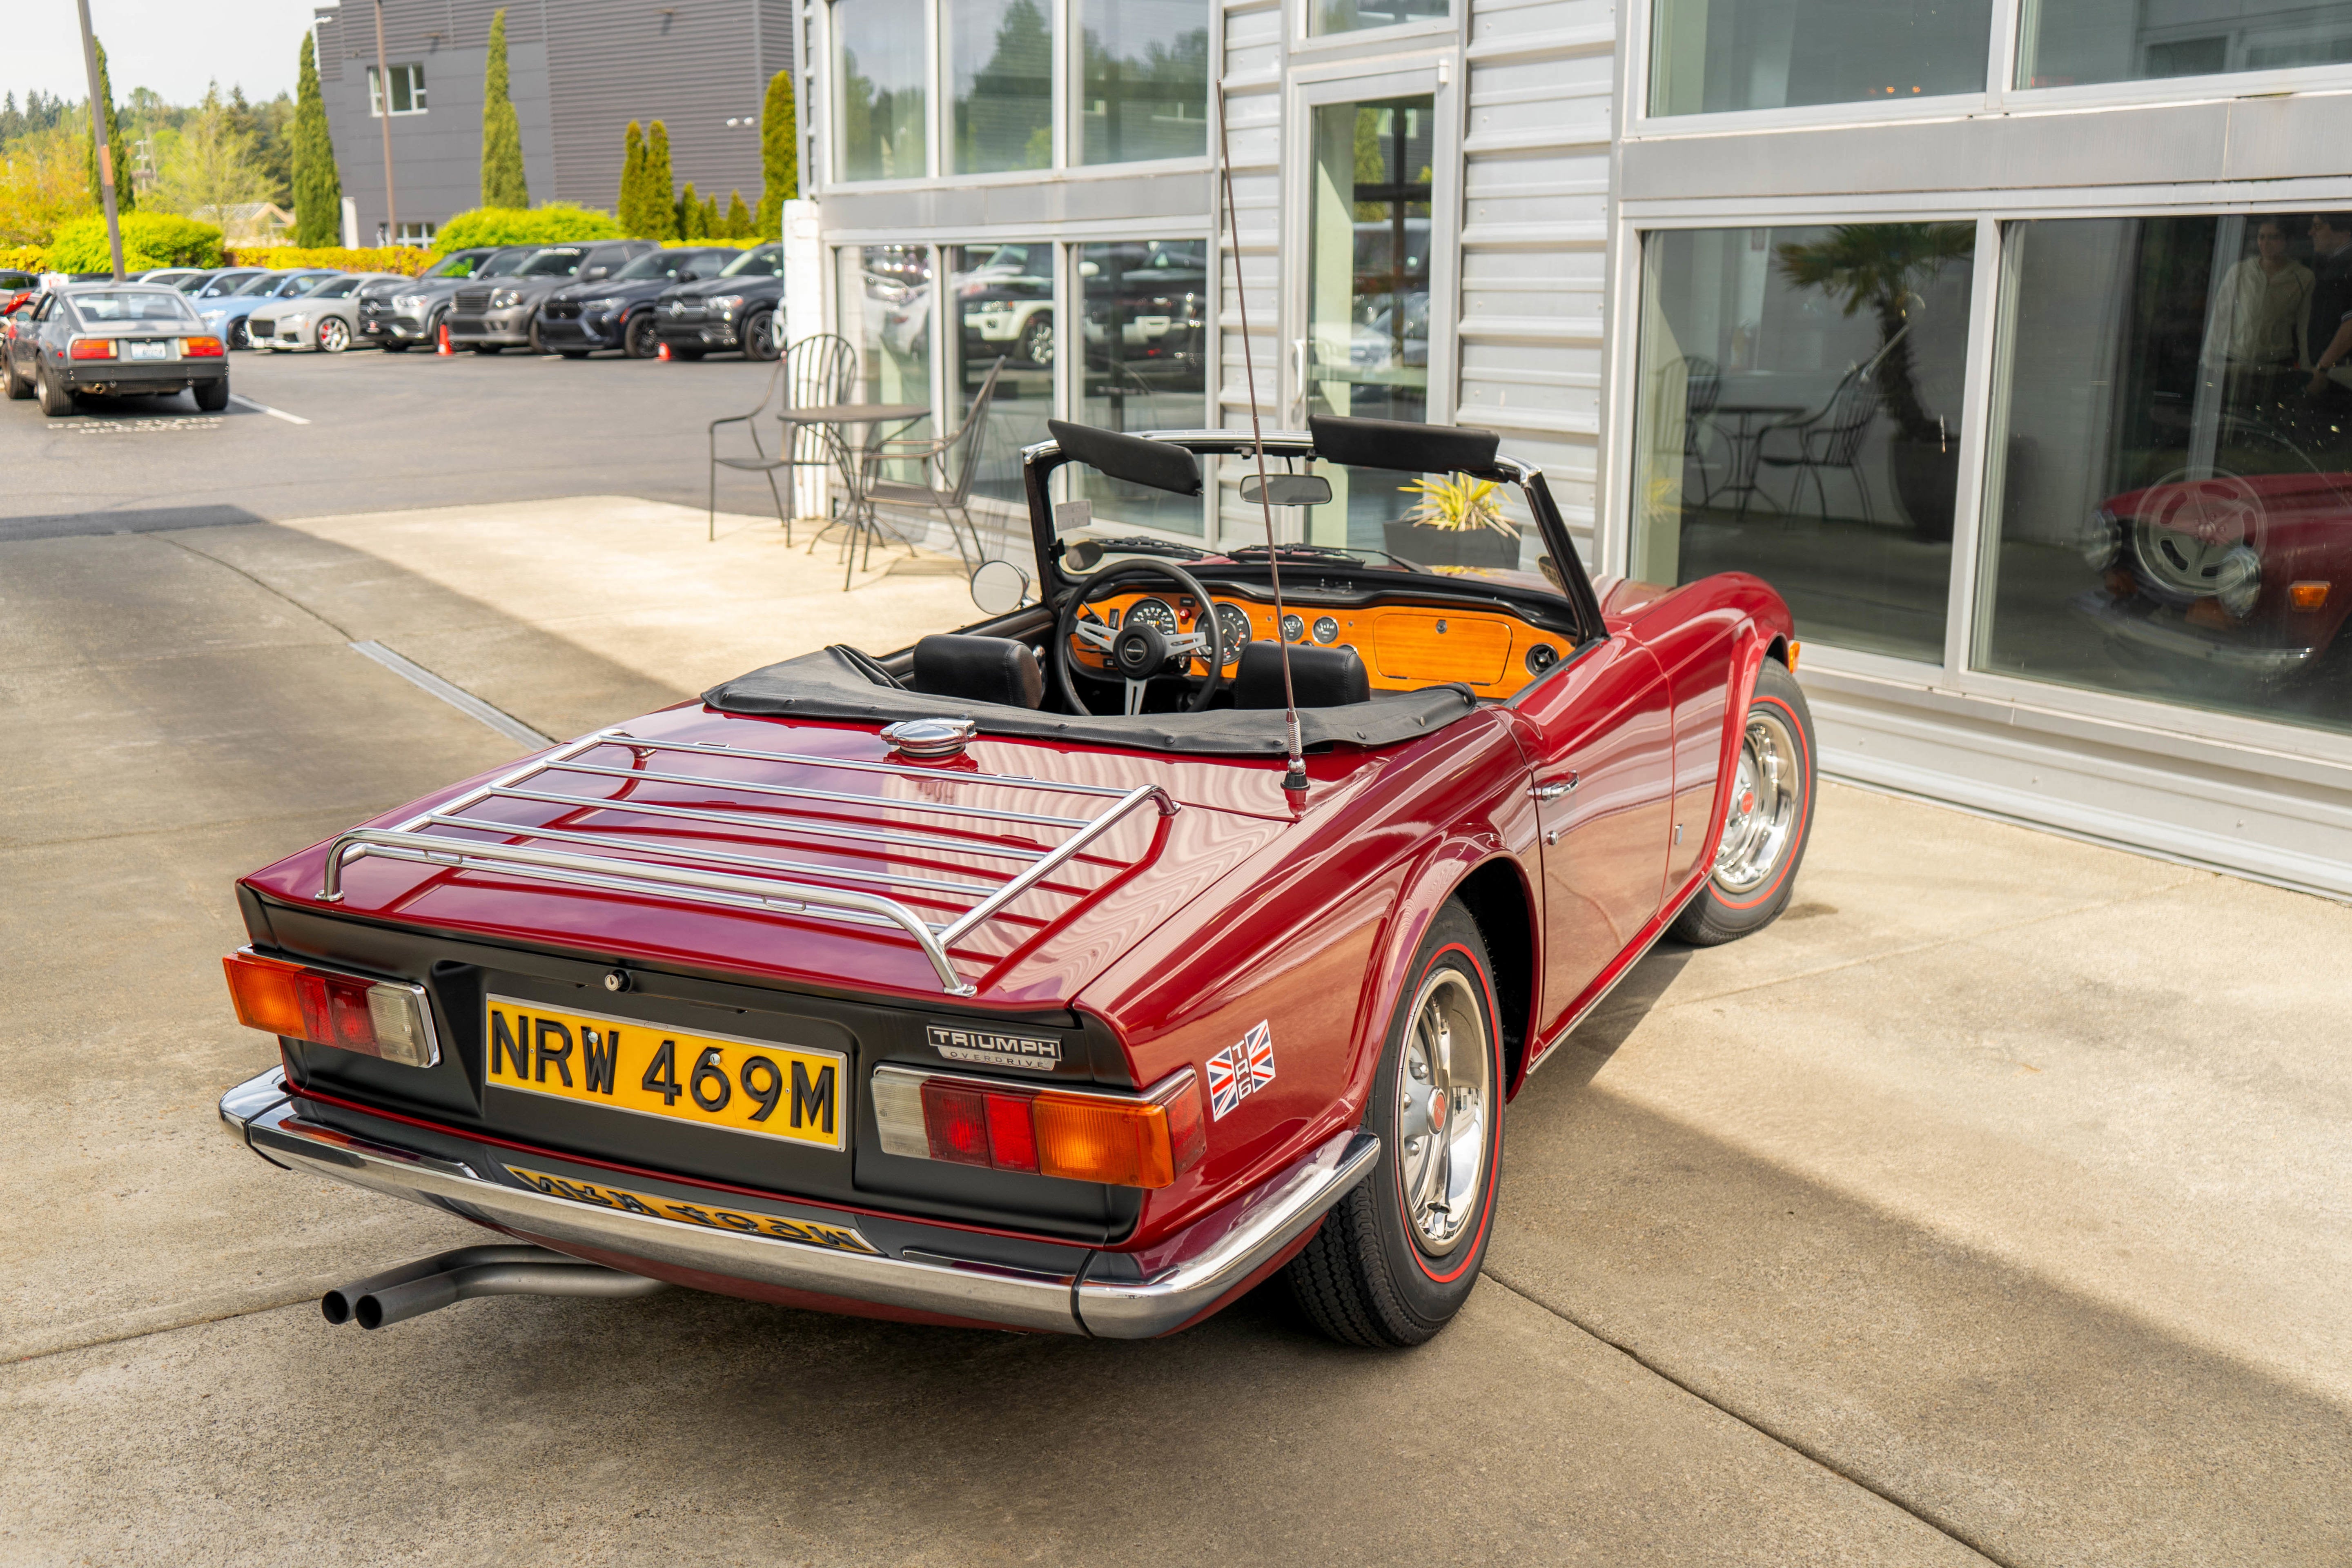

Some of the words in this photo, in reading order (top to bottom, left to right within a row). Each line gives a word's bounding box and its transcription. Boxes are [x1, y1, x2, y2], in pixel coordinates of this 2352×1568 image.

[933, 1030, 1056, 1056] TRIUMPH
[950, 1051, 1044, 1068] OVERDRIVE
[491, 1009, 619, 1096] NRW
[641, 1039, 835, 1134] 469M
[1232, 1039, 1252, 1100] TR6
